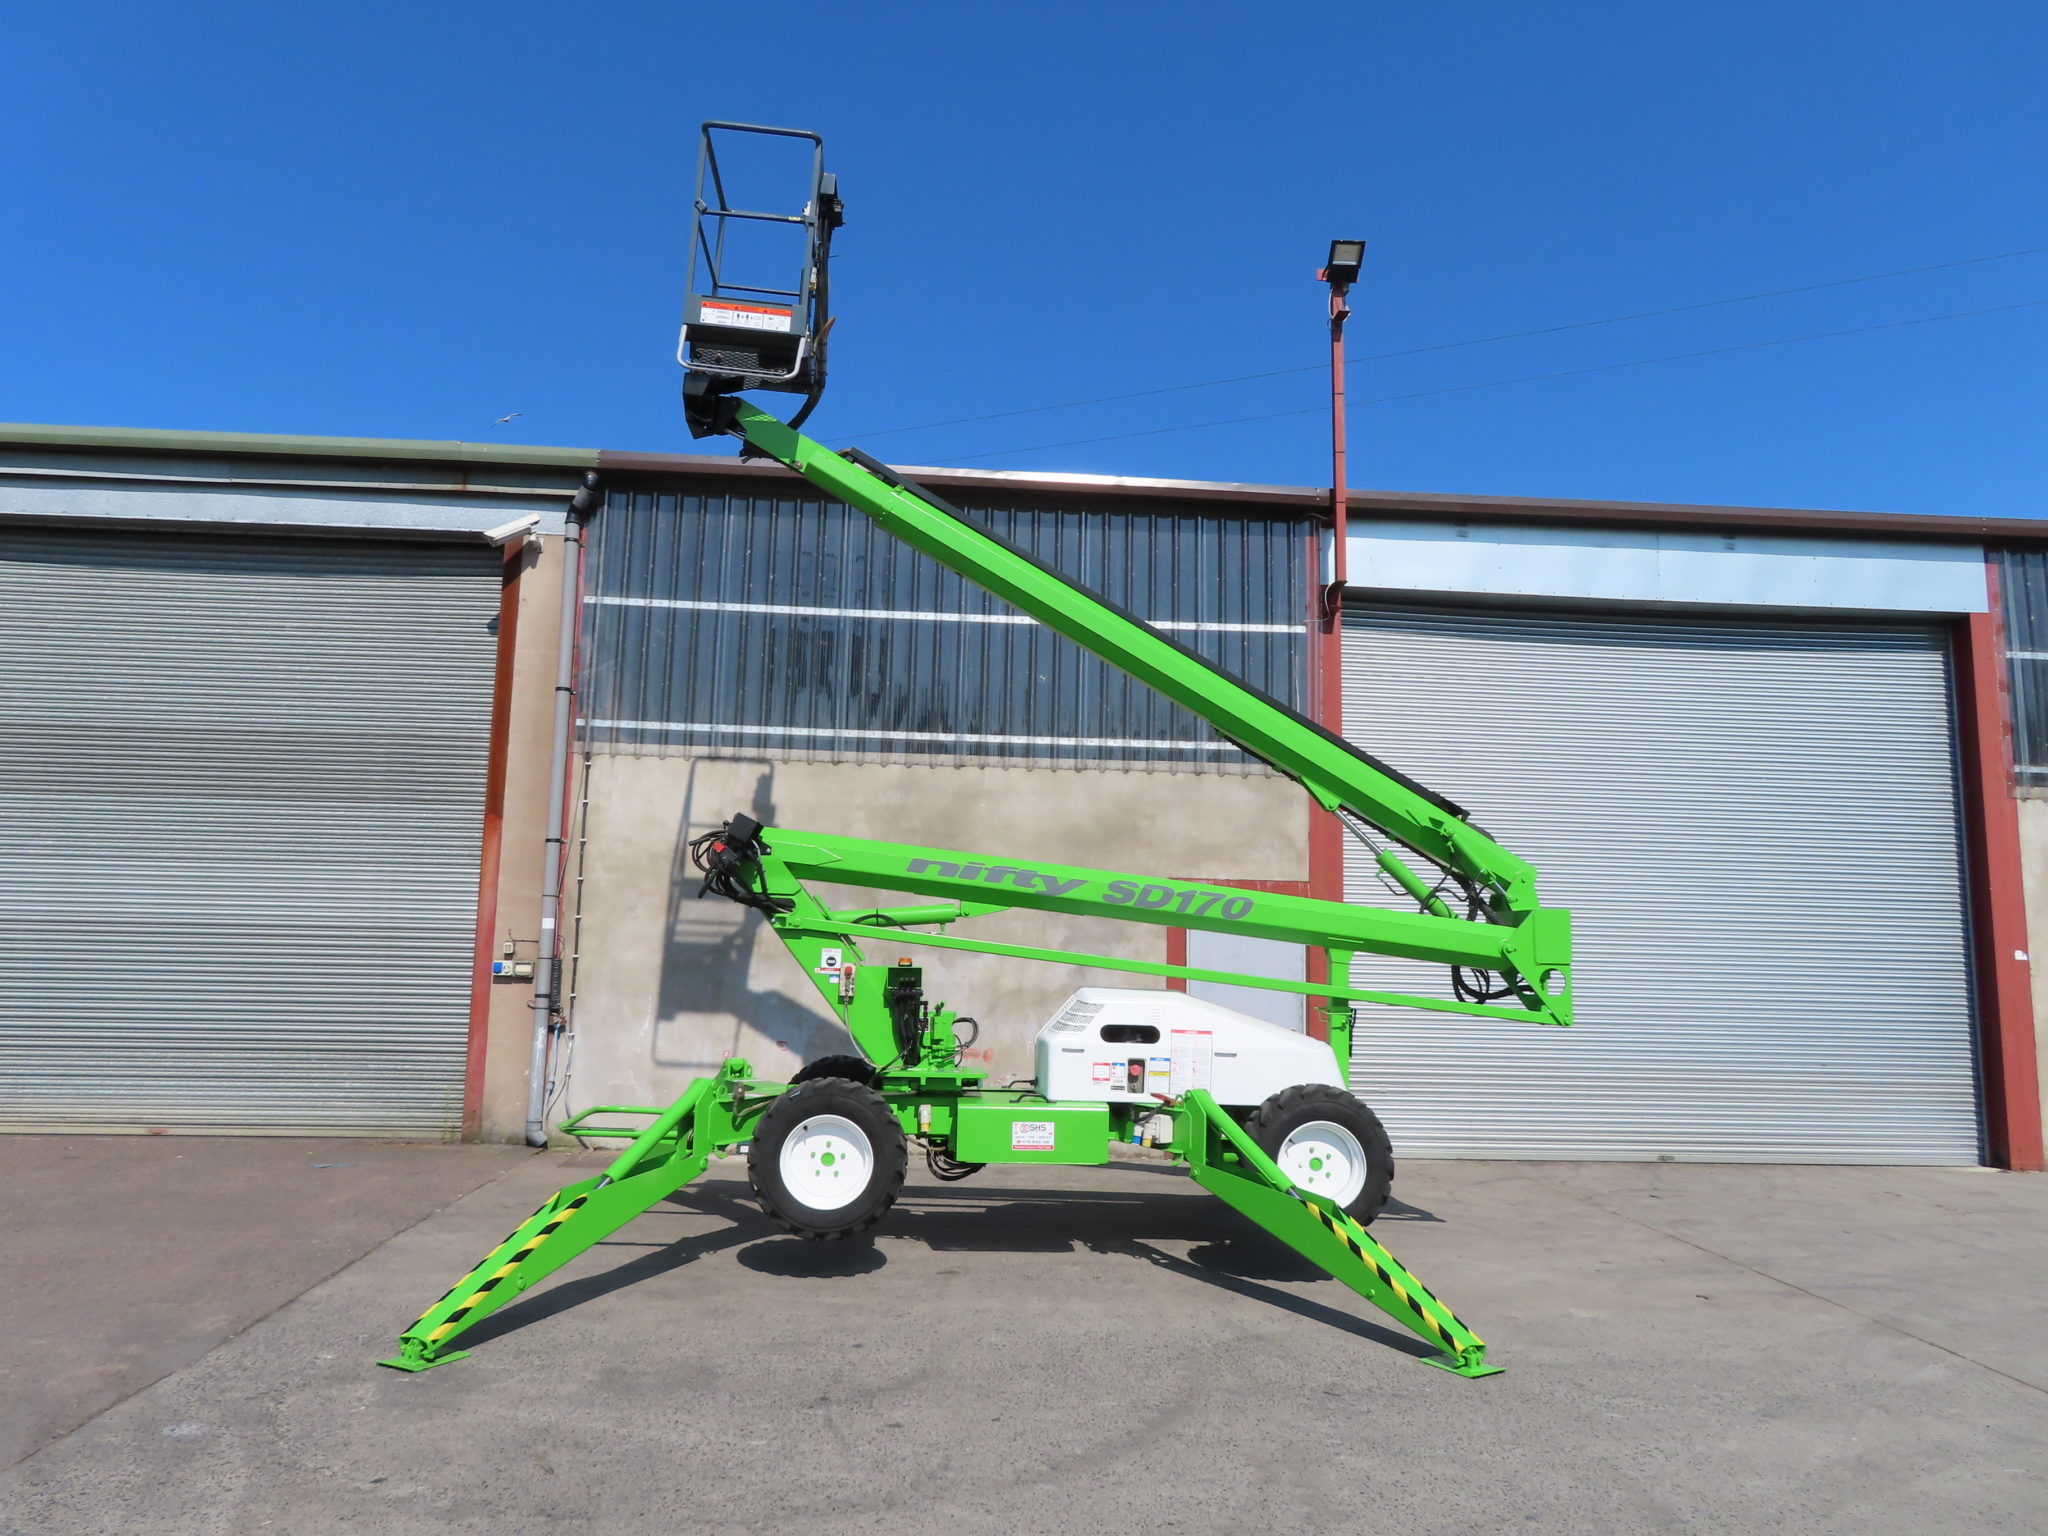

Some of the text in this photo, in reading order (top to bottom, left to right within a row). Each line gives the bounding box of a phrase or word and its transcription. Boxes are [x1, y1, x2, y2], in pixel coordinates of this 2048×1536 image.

[907, 858, 1254, 920] nifty SD170
[1029, 1123, 1047, 1132] SHS
